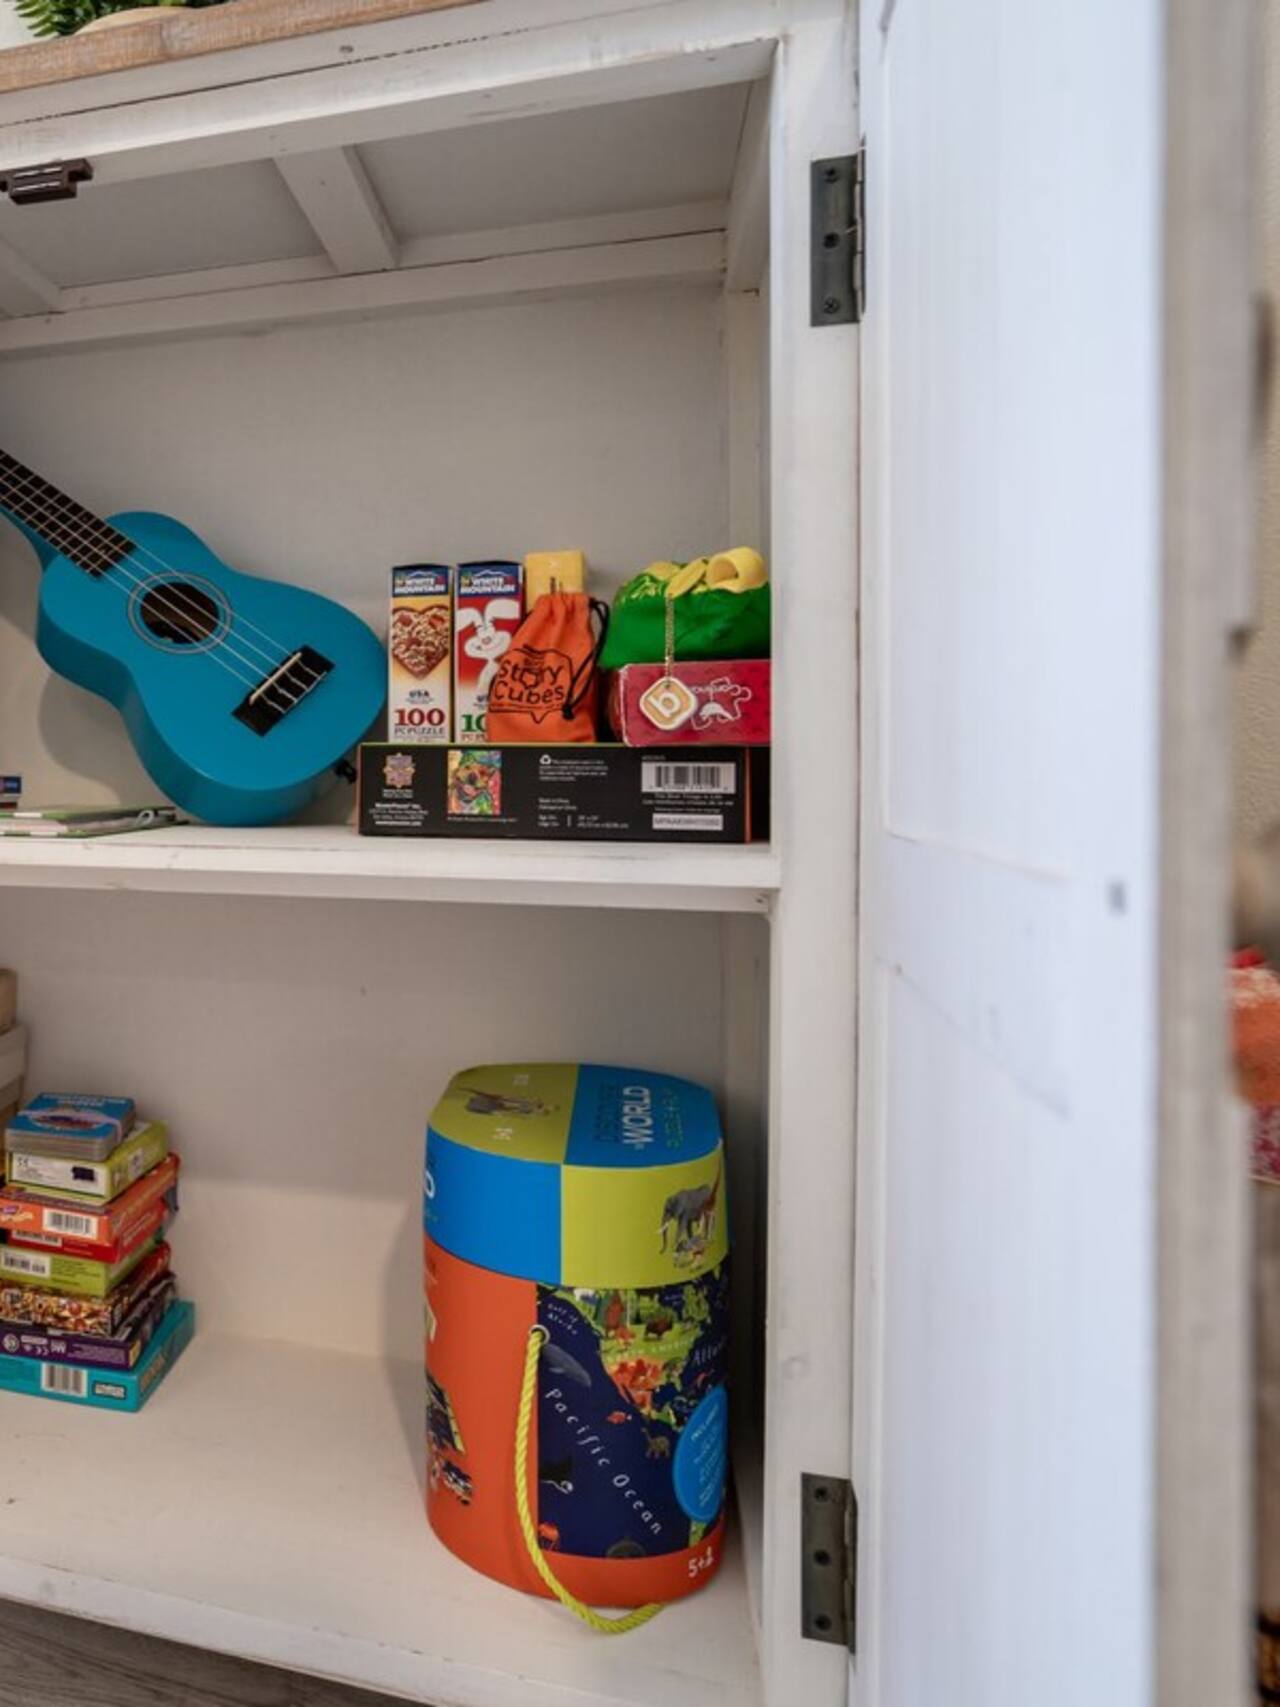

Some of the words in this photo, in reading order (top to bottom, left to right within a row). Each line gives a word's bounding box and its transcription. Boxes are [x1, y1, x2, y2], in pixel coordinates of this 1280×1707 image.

[495, 680, 565, 704] Cubes
[394, 708, 446, 727] 100
[461, 714, 488, 732] 10
[621, 1085, 654, 1144] WORLD
[545, 1388, 610, 1467] Pacific
[613, 1473, 663, 1535] Ocean
